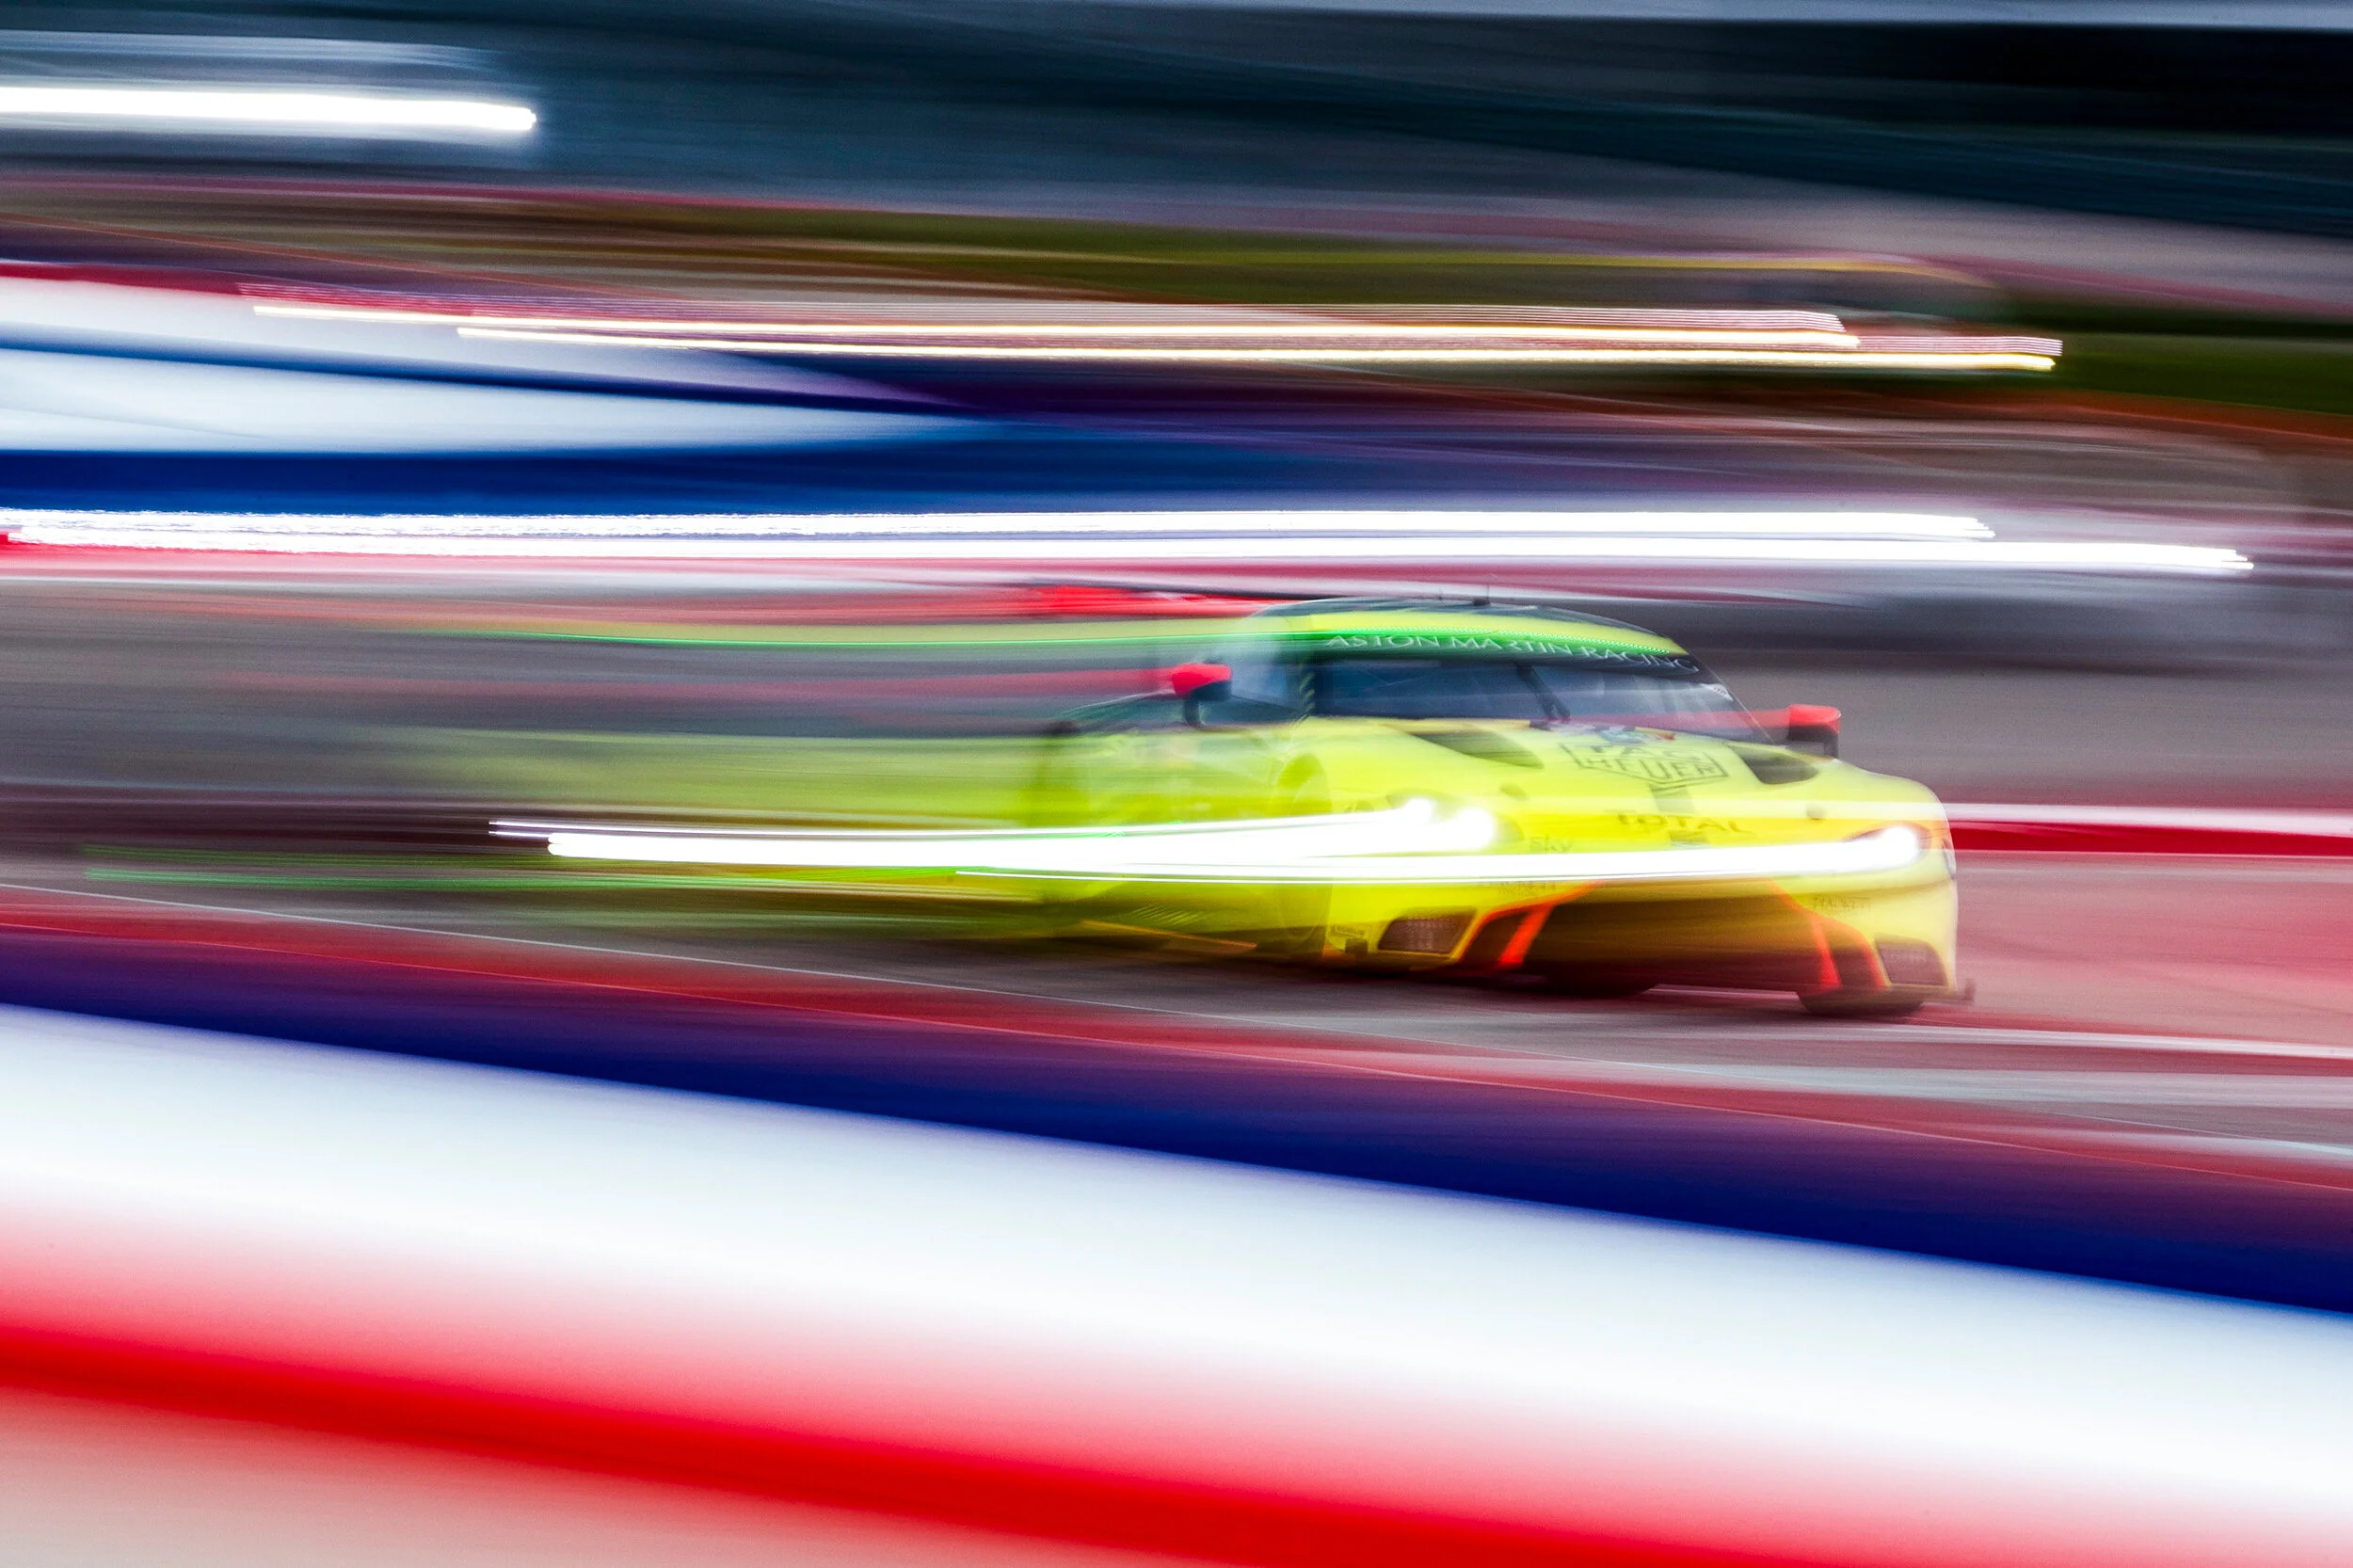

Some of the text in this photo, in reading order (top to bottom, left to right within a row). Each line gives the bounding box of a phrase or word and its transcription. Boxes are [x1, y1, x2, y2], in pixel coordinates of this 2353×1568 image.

[1325, 634, 1440, 648] ASTON
[1581, 647, 1699, 672] RACING
[1585, 756, 1720, 780] HEUER
[1603, 810, 1758, 834] TOTAL
